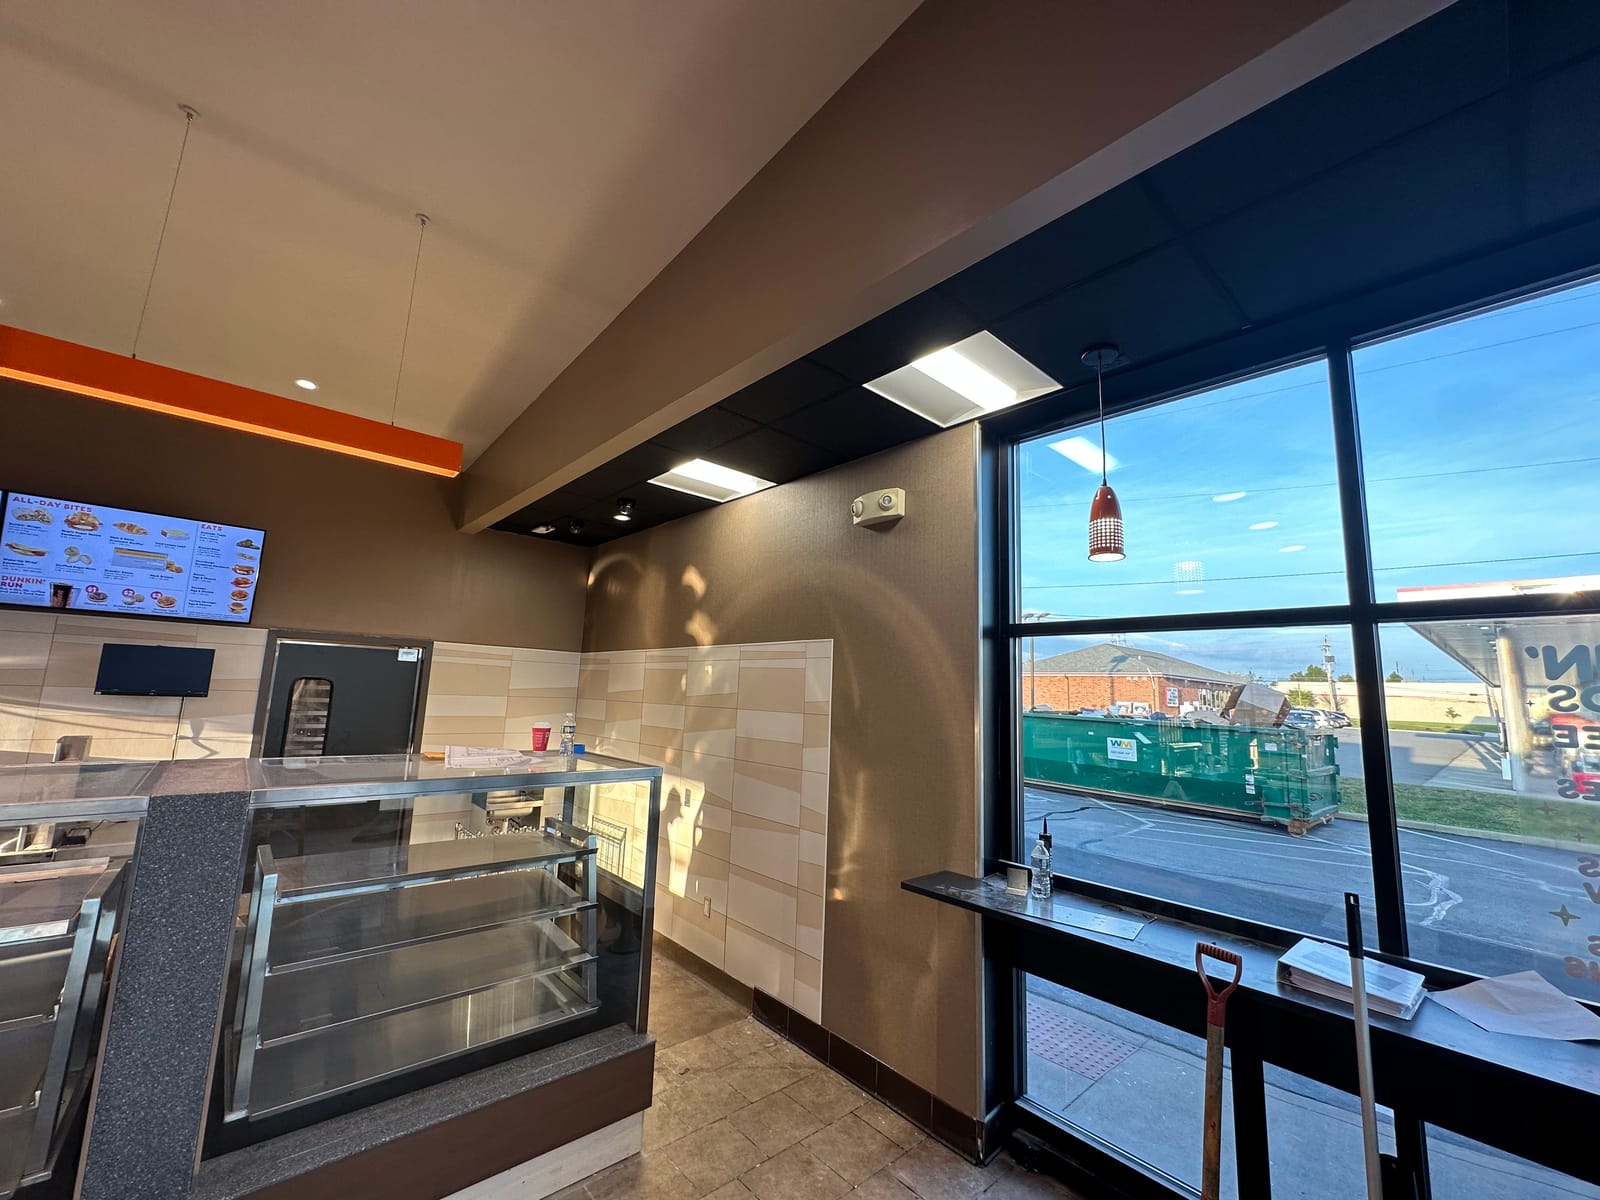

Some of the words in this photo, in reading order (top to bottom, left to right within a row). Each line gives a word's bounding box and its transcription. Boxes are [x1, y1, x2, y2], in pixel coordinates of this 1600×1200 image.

[12, 496, 61, 509] ALL-DAY
[63, 503, 93, 513] BITES
[201, 523, 223, 532] EATS
[0, 581, 23, 589] RUN
[1110, 739, 1132, 748] WM
